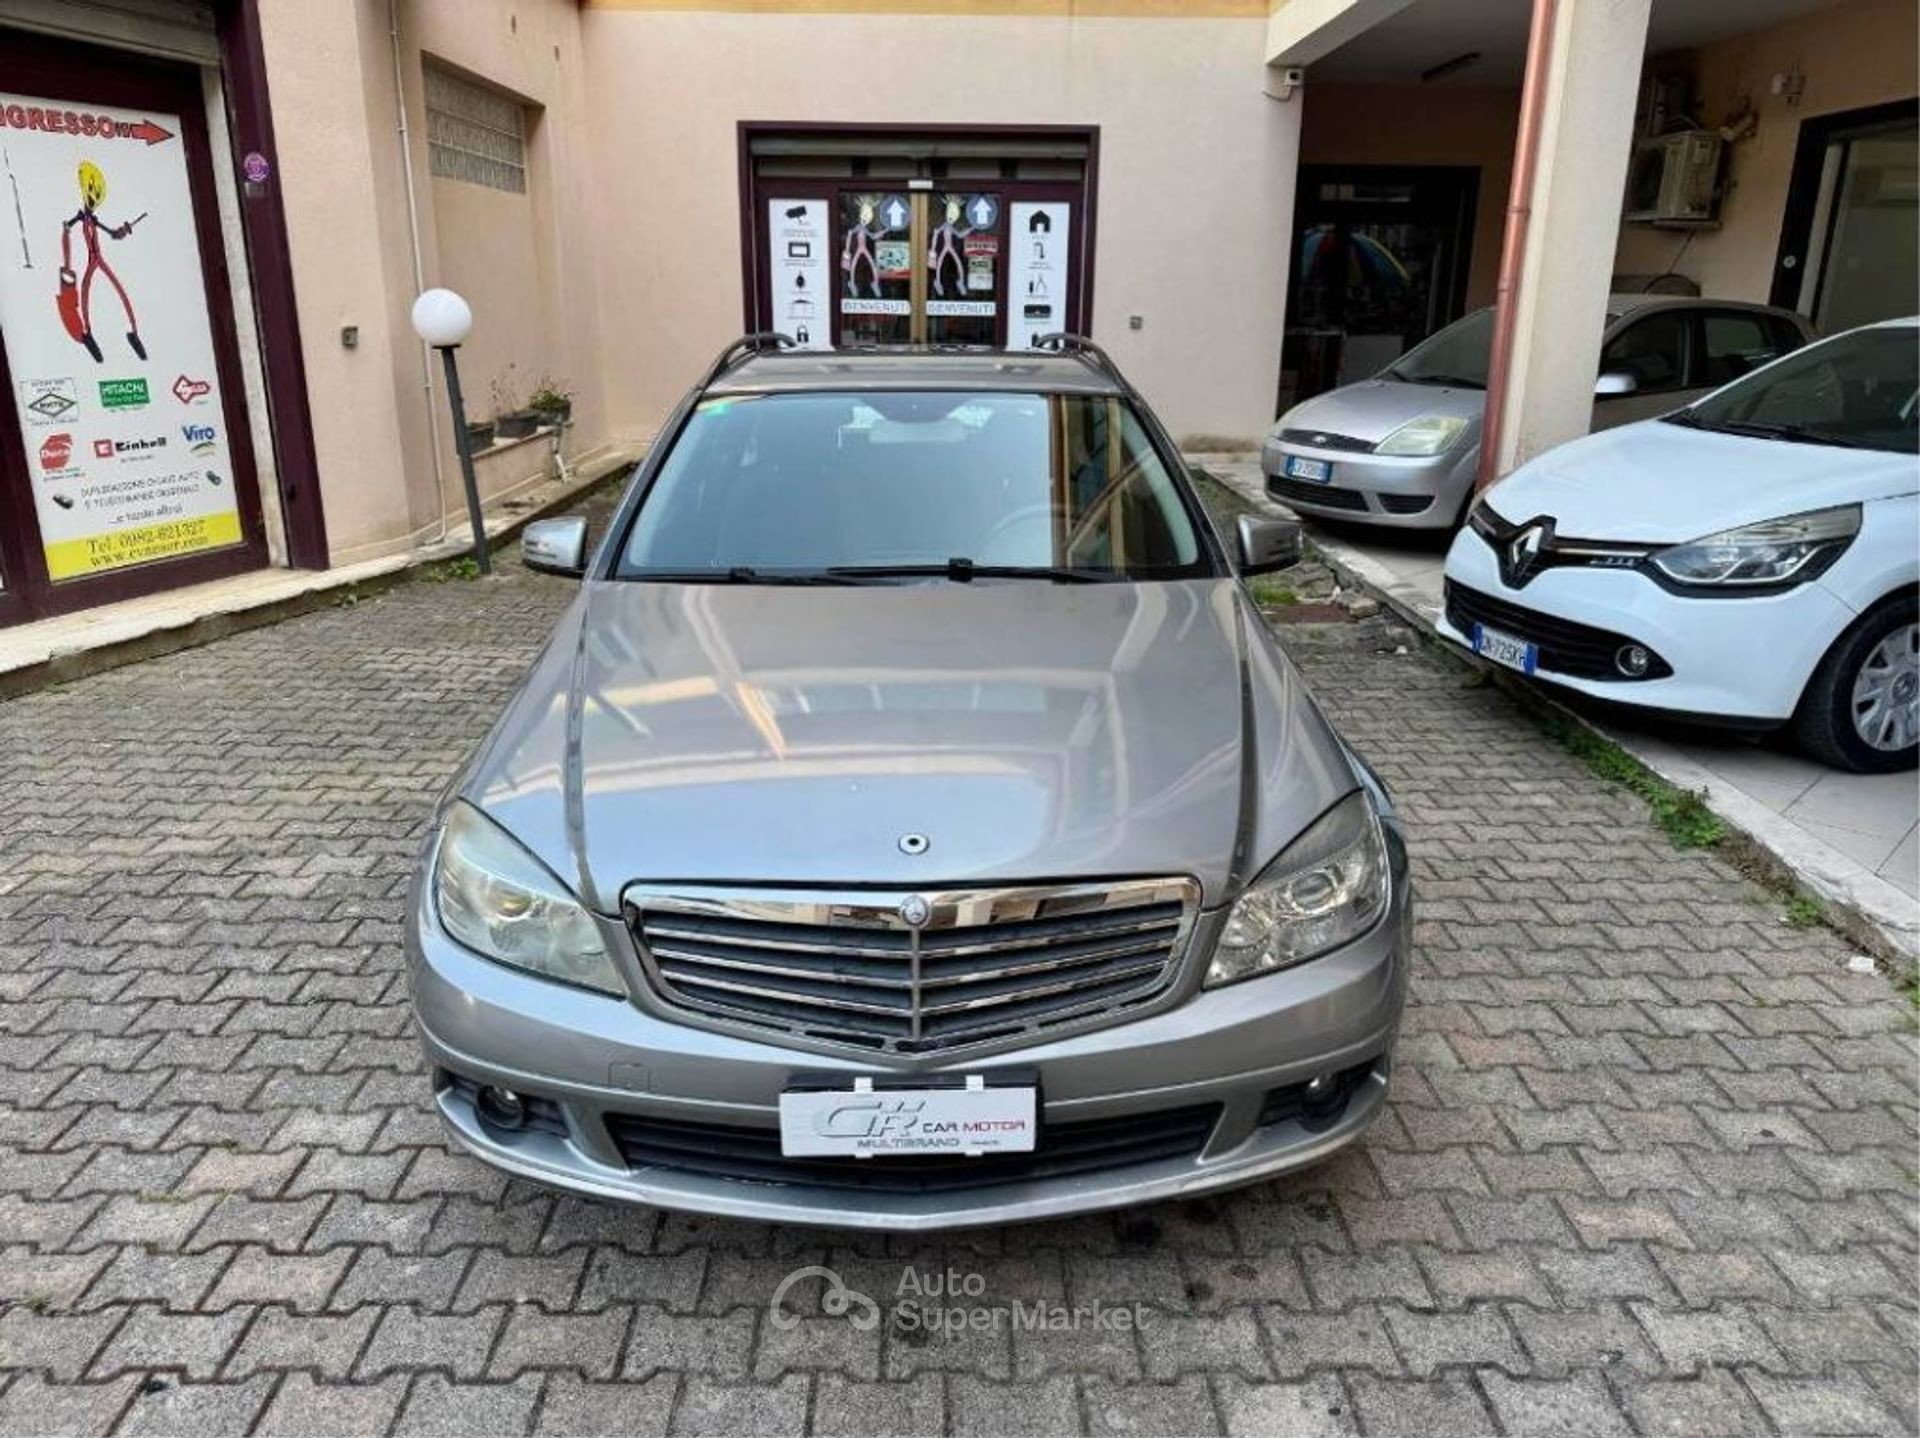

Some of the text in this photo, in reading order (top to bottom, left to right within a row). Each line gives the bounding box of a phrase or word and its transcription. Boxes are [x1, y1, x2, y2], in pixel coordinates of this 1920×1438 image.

[928, 302, 993, 315] BENVENUTI
[103, 382, 145, 395] HITACHI
[182, 425, 215, 440] Viro
[115, 437, 167, 451] Einhell
[922, 1120, 1025, 1134] CAR MOTOR
[857, 1138, 960, 1149] MULTIBRAND
